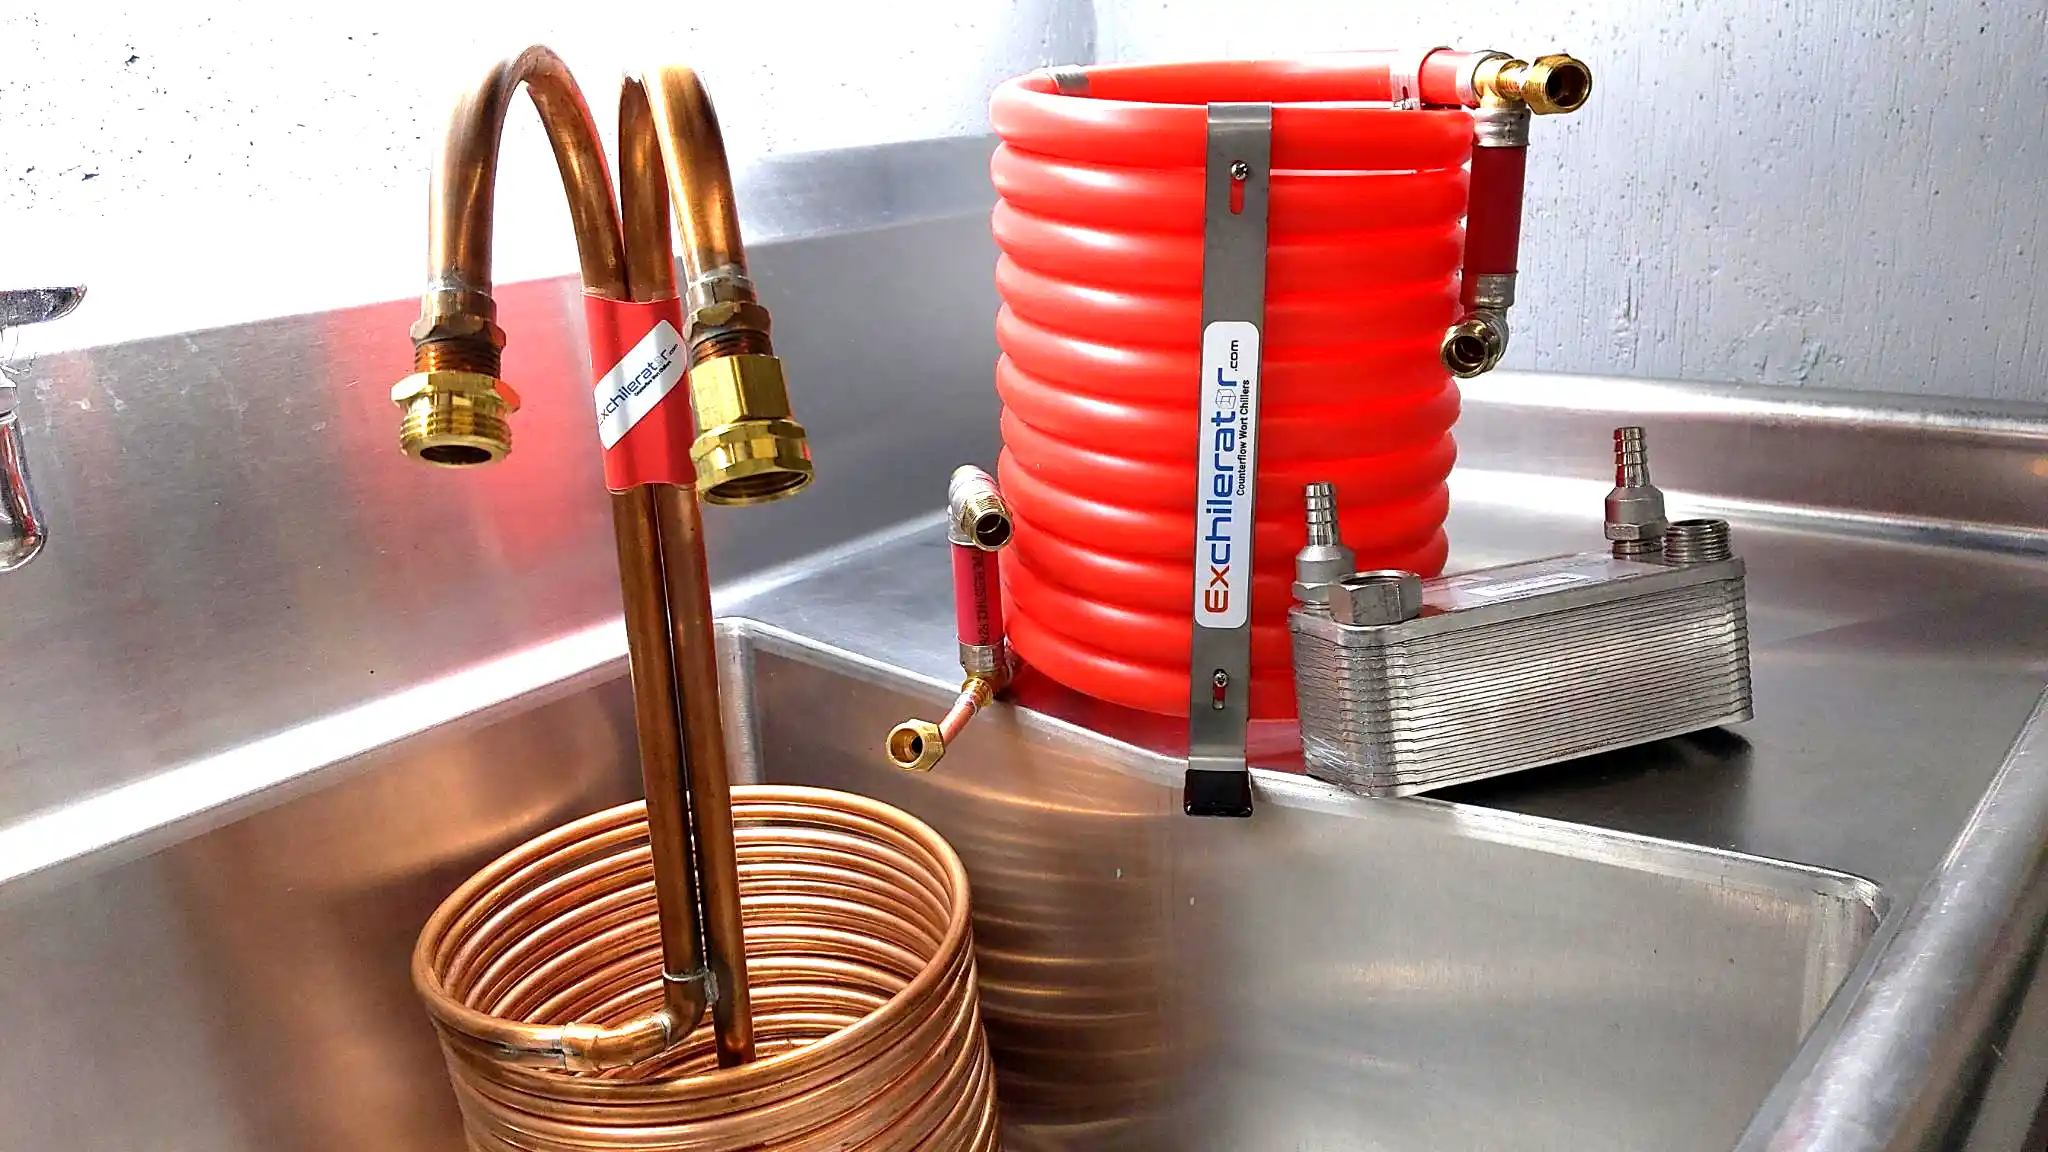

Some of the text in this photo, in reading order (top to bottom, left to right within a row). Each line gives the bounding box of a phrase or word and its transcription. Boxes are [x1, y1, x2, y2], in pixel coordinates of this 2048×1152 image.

[1236, 379, 1250, 496] Counterflow Wort Chillers
